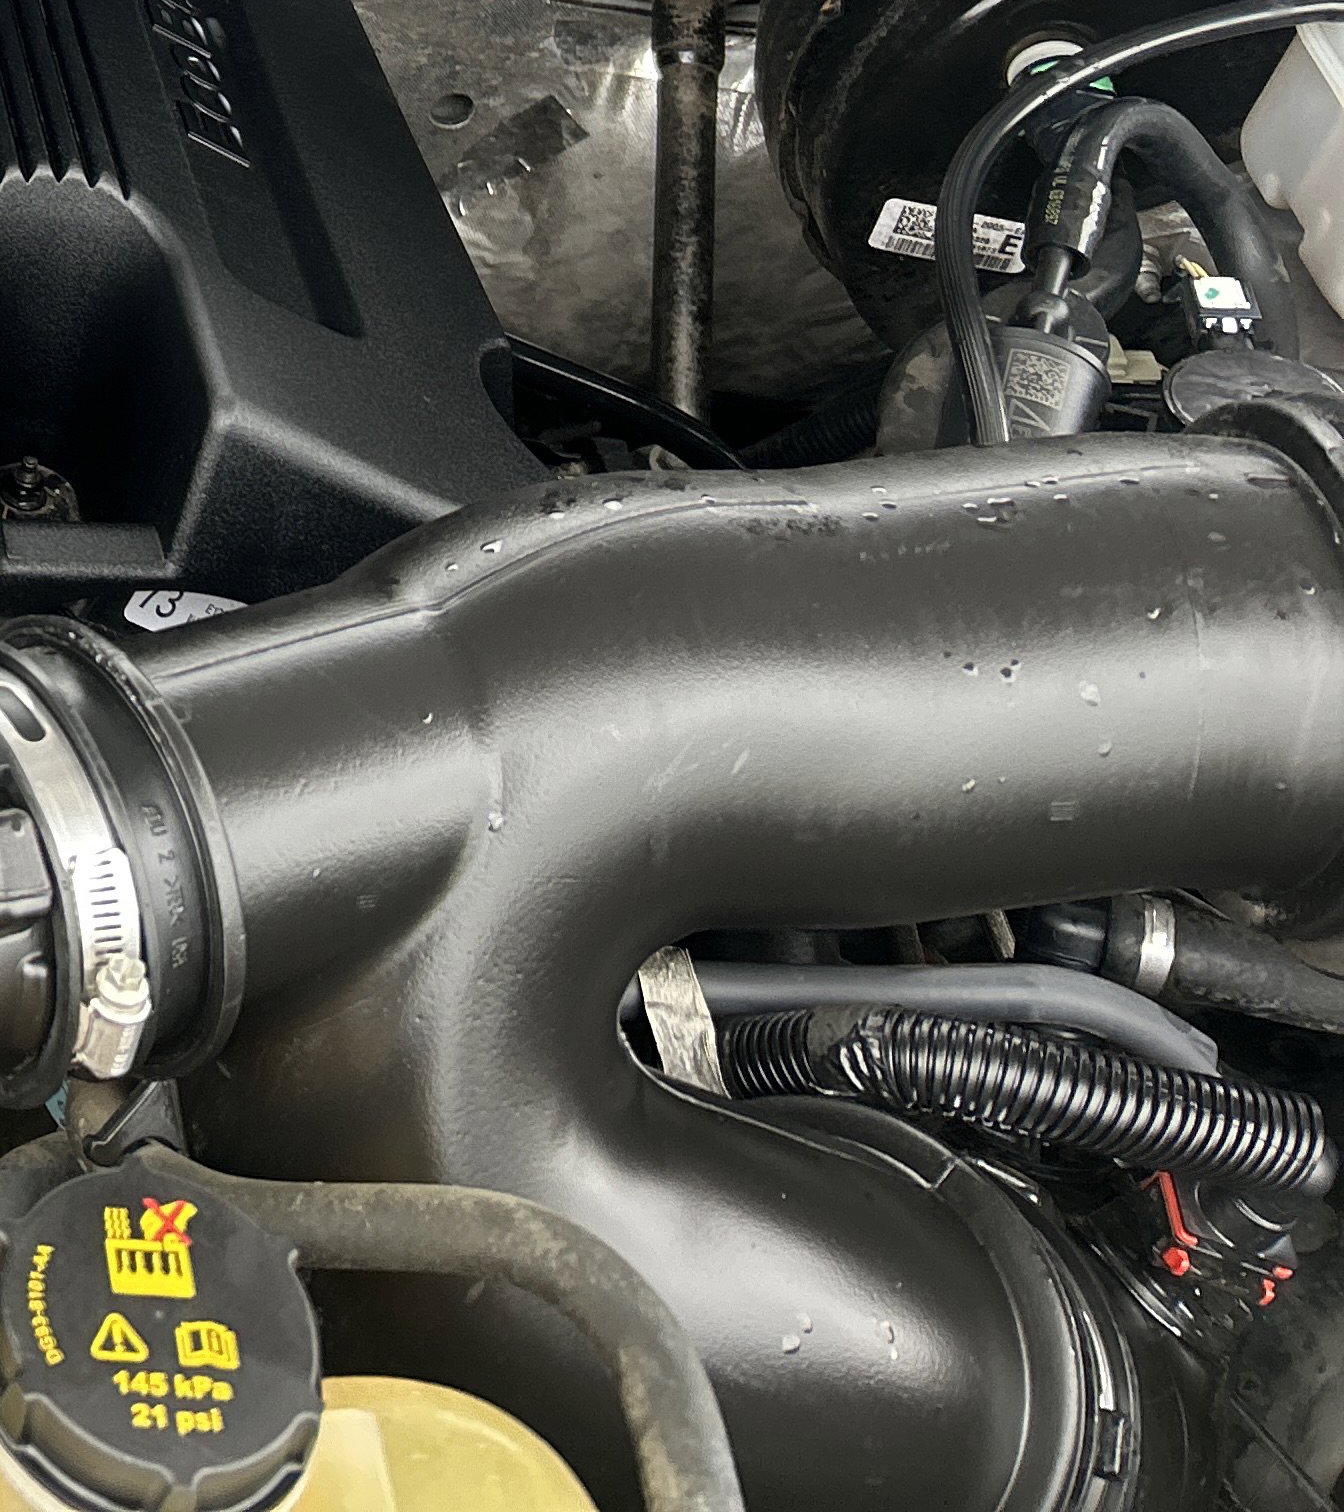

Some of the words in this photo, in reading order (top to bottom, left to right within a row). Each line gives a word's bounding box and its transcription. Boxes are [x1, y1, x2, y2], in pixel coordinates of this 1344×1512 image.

[999, 235, 1022, 255] E
[113, 1370, 169, 1397] 145
[174, 1372, 234, 1402] kPa
[130, 1403, 169, 1429] 21
[175, 1407, 224, 1437] psi
